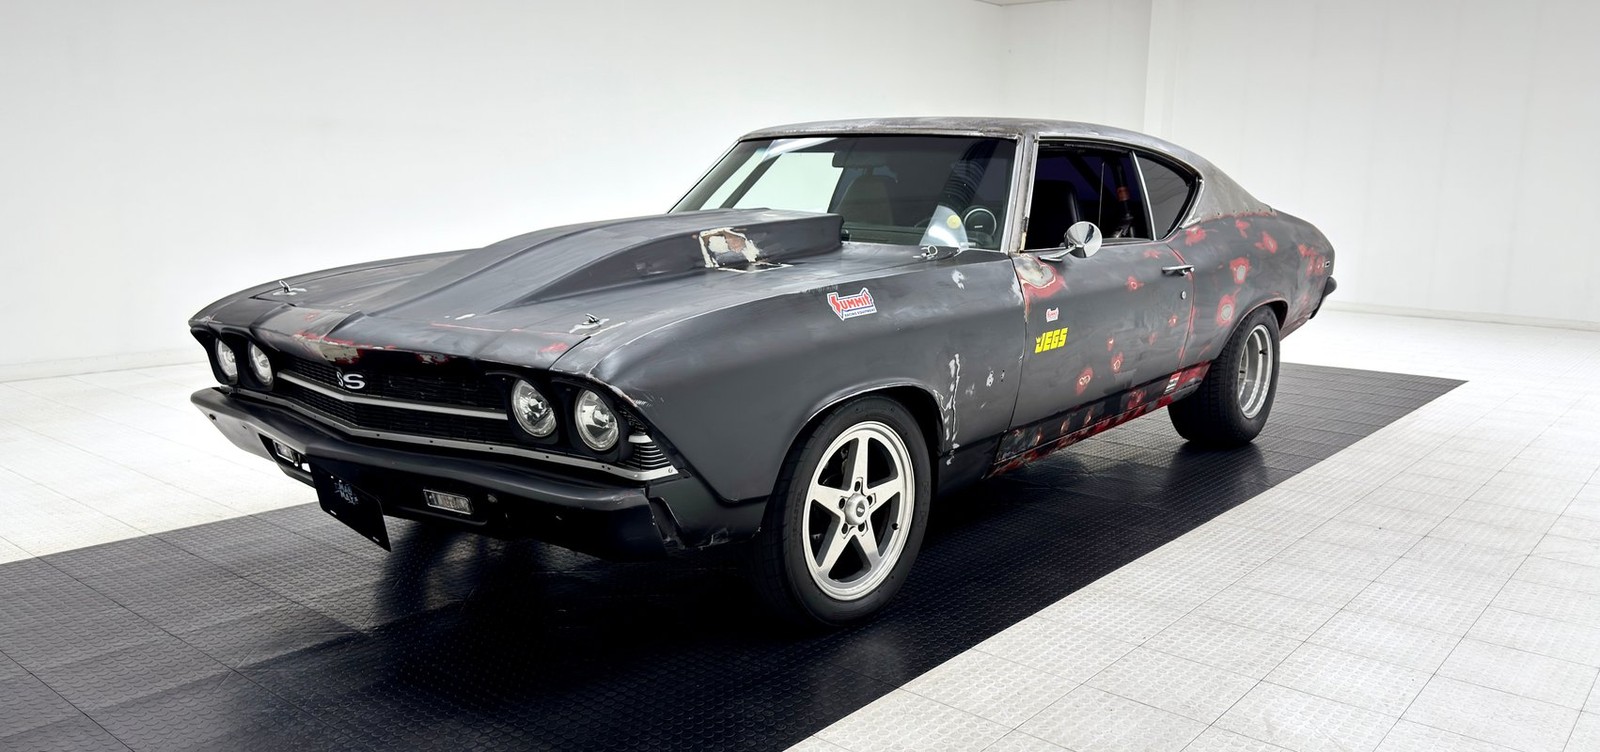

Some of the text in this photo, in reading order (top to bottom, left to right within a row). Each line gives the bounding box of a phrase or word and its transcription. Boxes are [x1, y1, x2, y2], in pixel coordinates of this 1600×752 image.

[830, 291, 872, 313] SUMMIT
[1035, 327, 1068, 353] JEGS
[336, 371, 366, 389] SS
